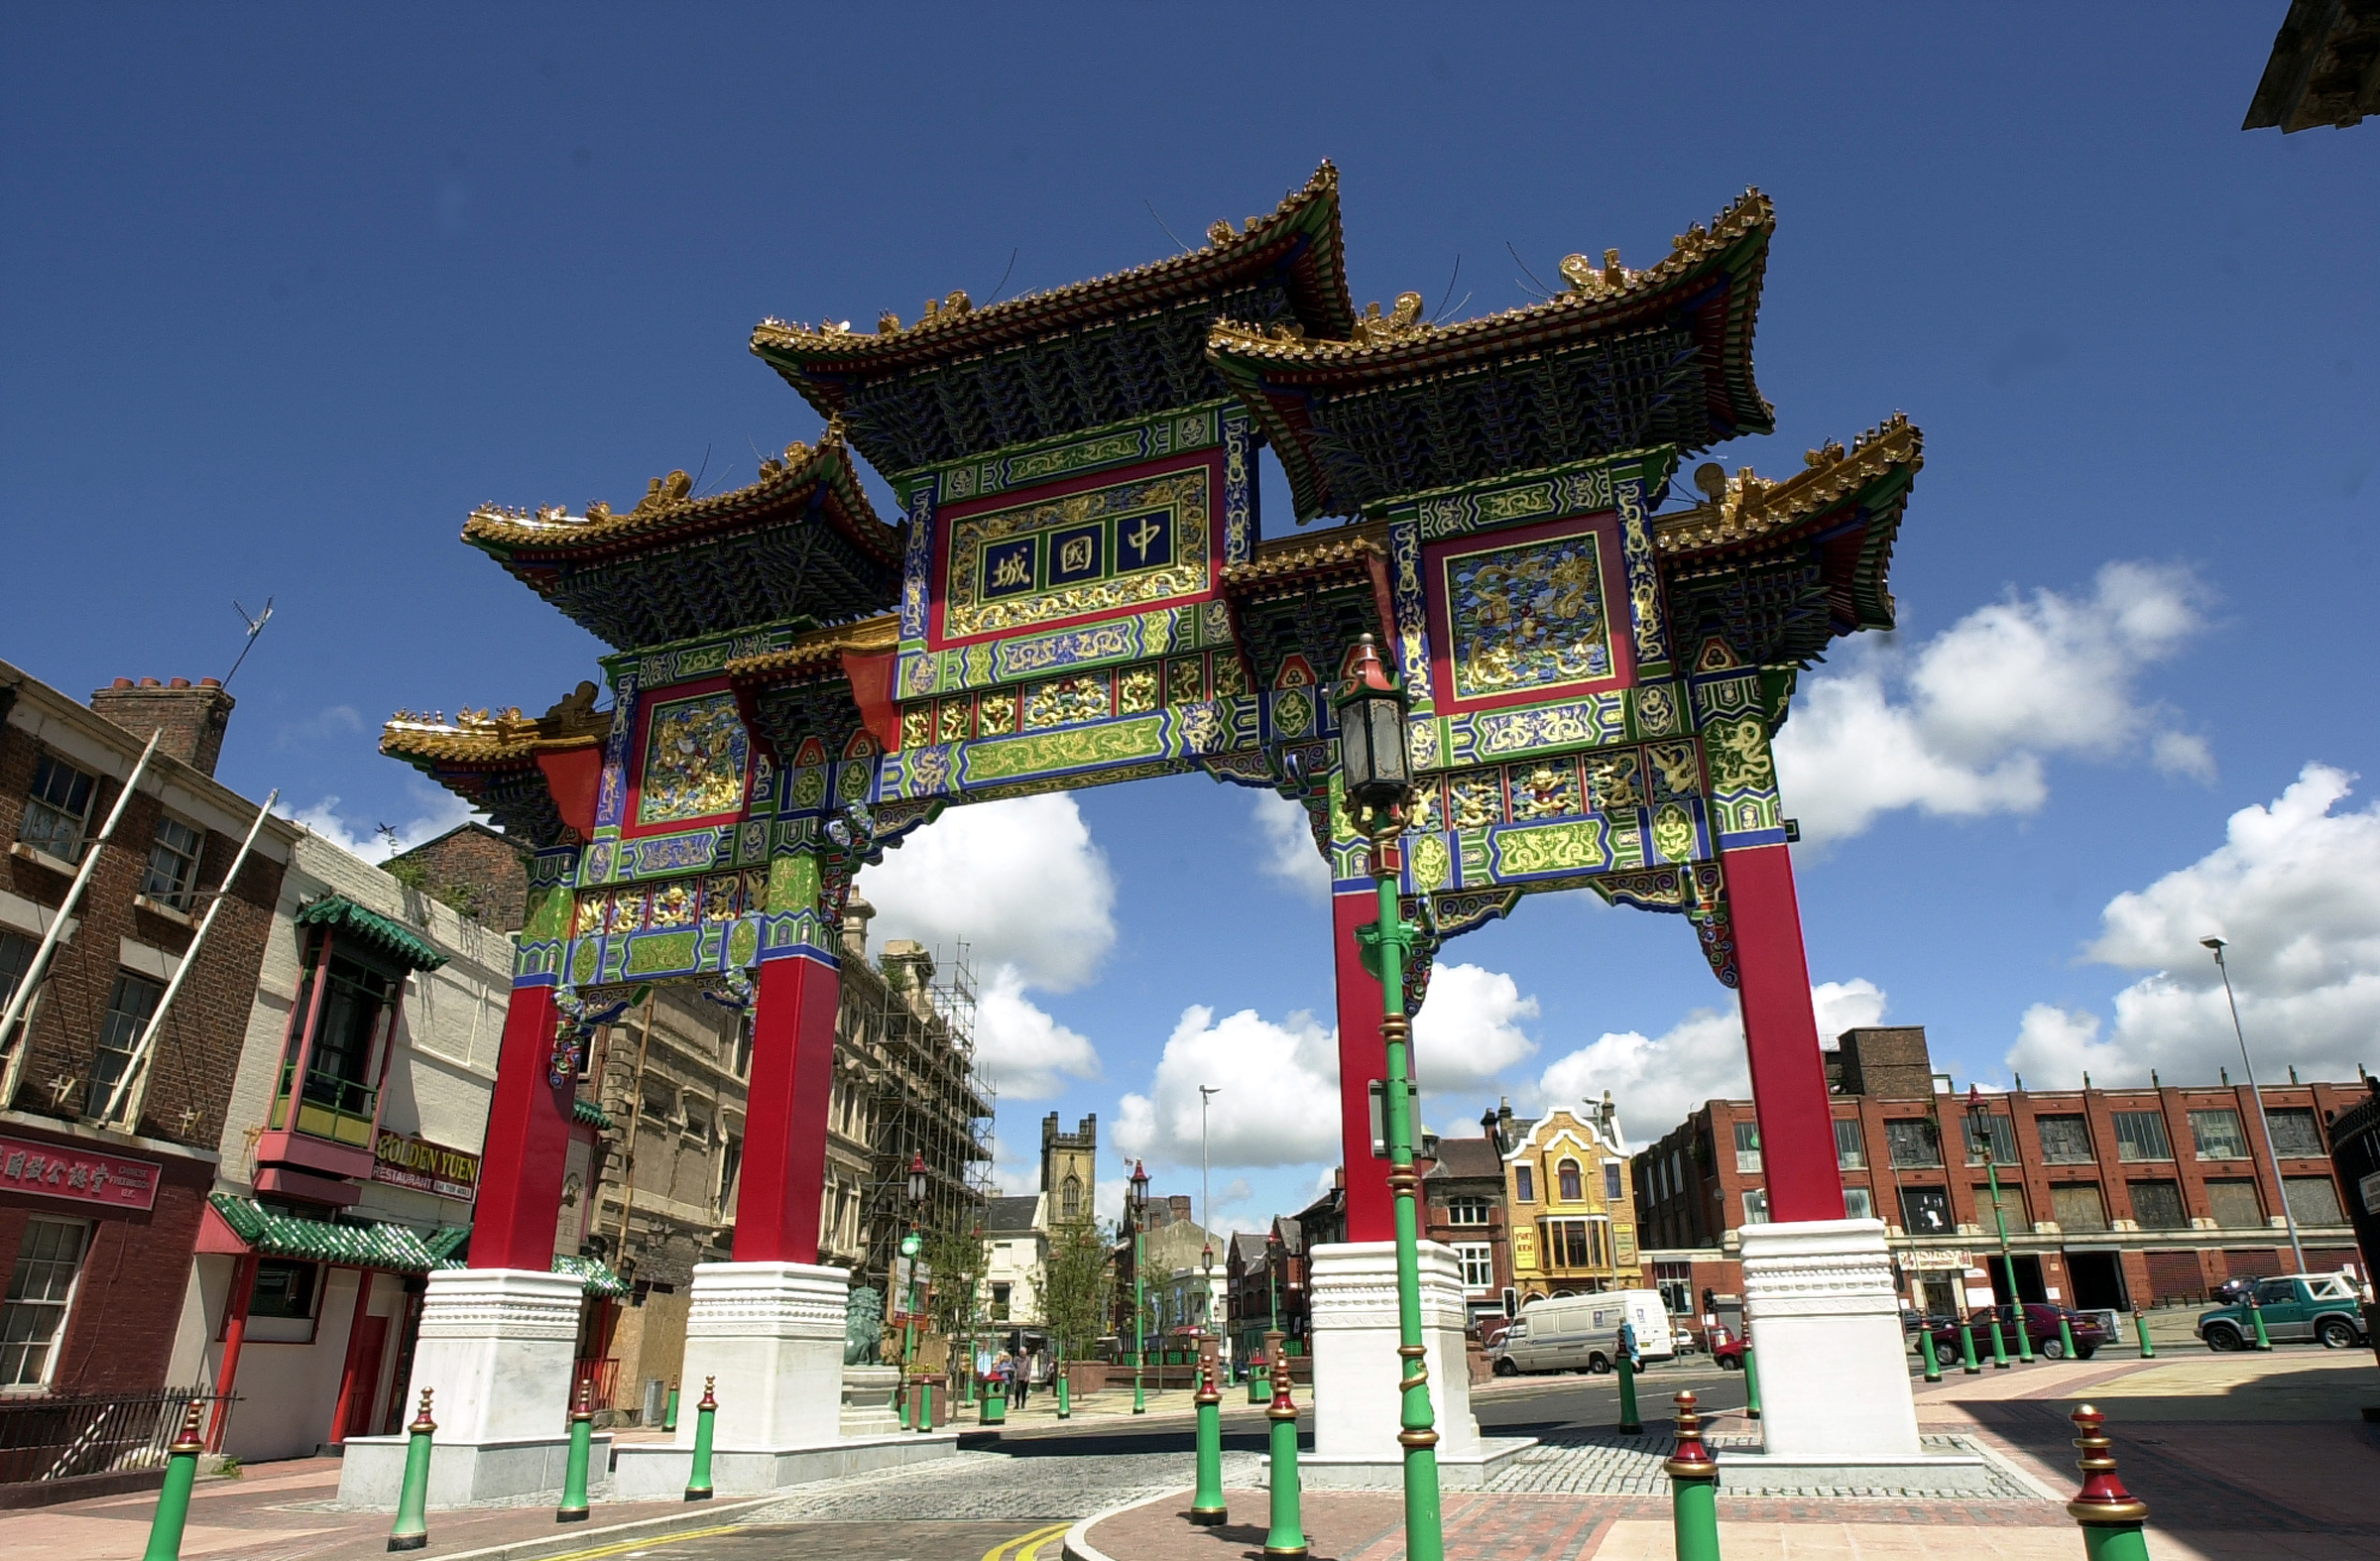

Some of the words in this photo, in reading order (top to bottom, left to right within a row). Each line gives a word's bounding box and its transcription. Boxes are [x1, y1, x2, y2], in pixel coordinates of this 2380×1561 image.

[377, 1135, 438, 1173] GOLDEN
[440, 1151, 477, 1182] YUEN
[372, 1165, 432, 1189] RESTAURANT
